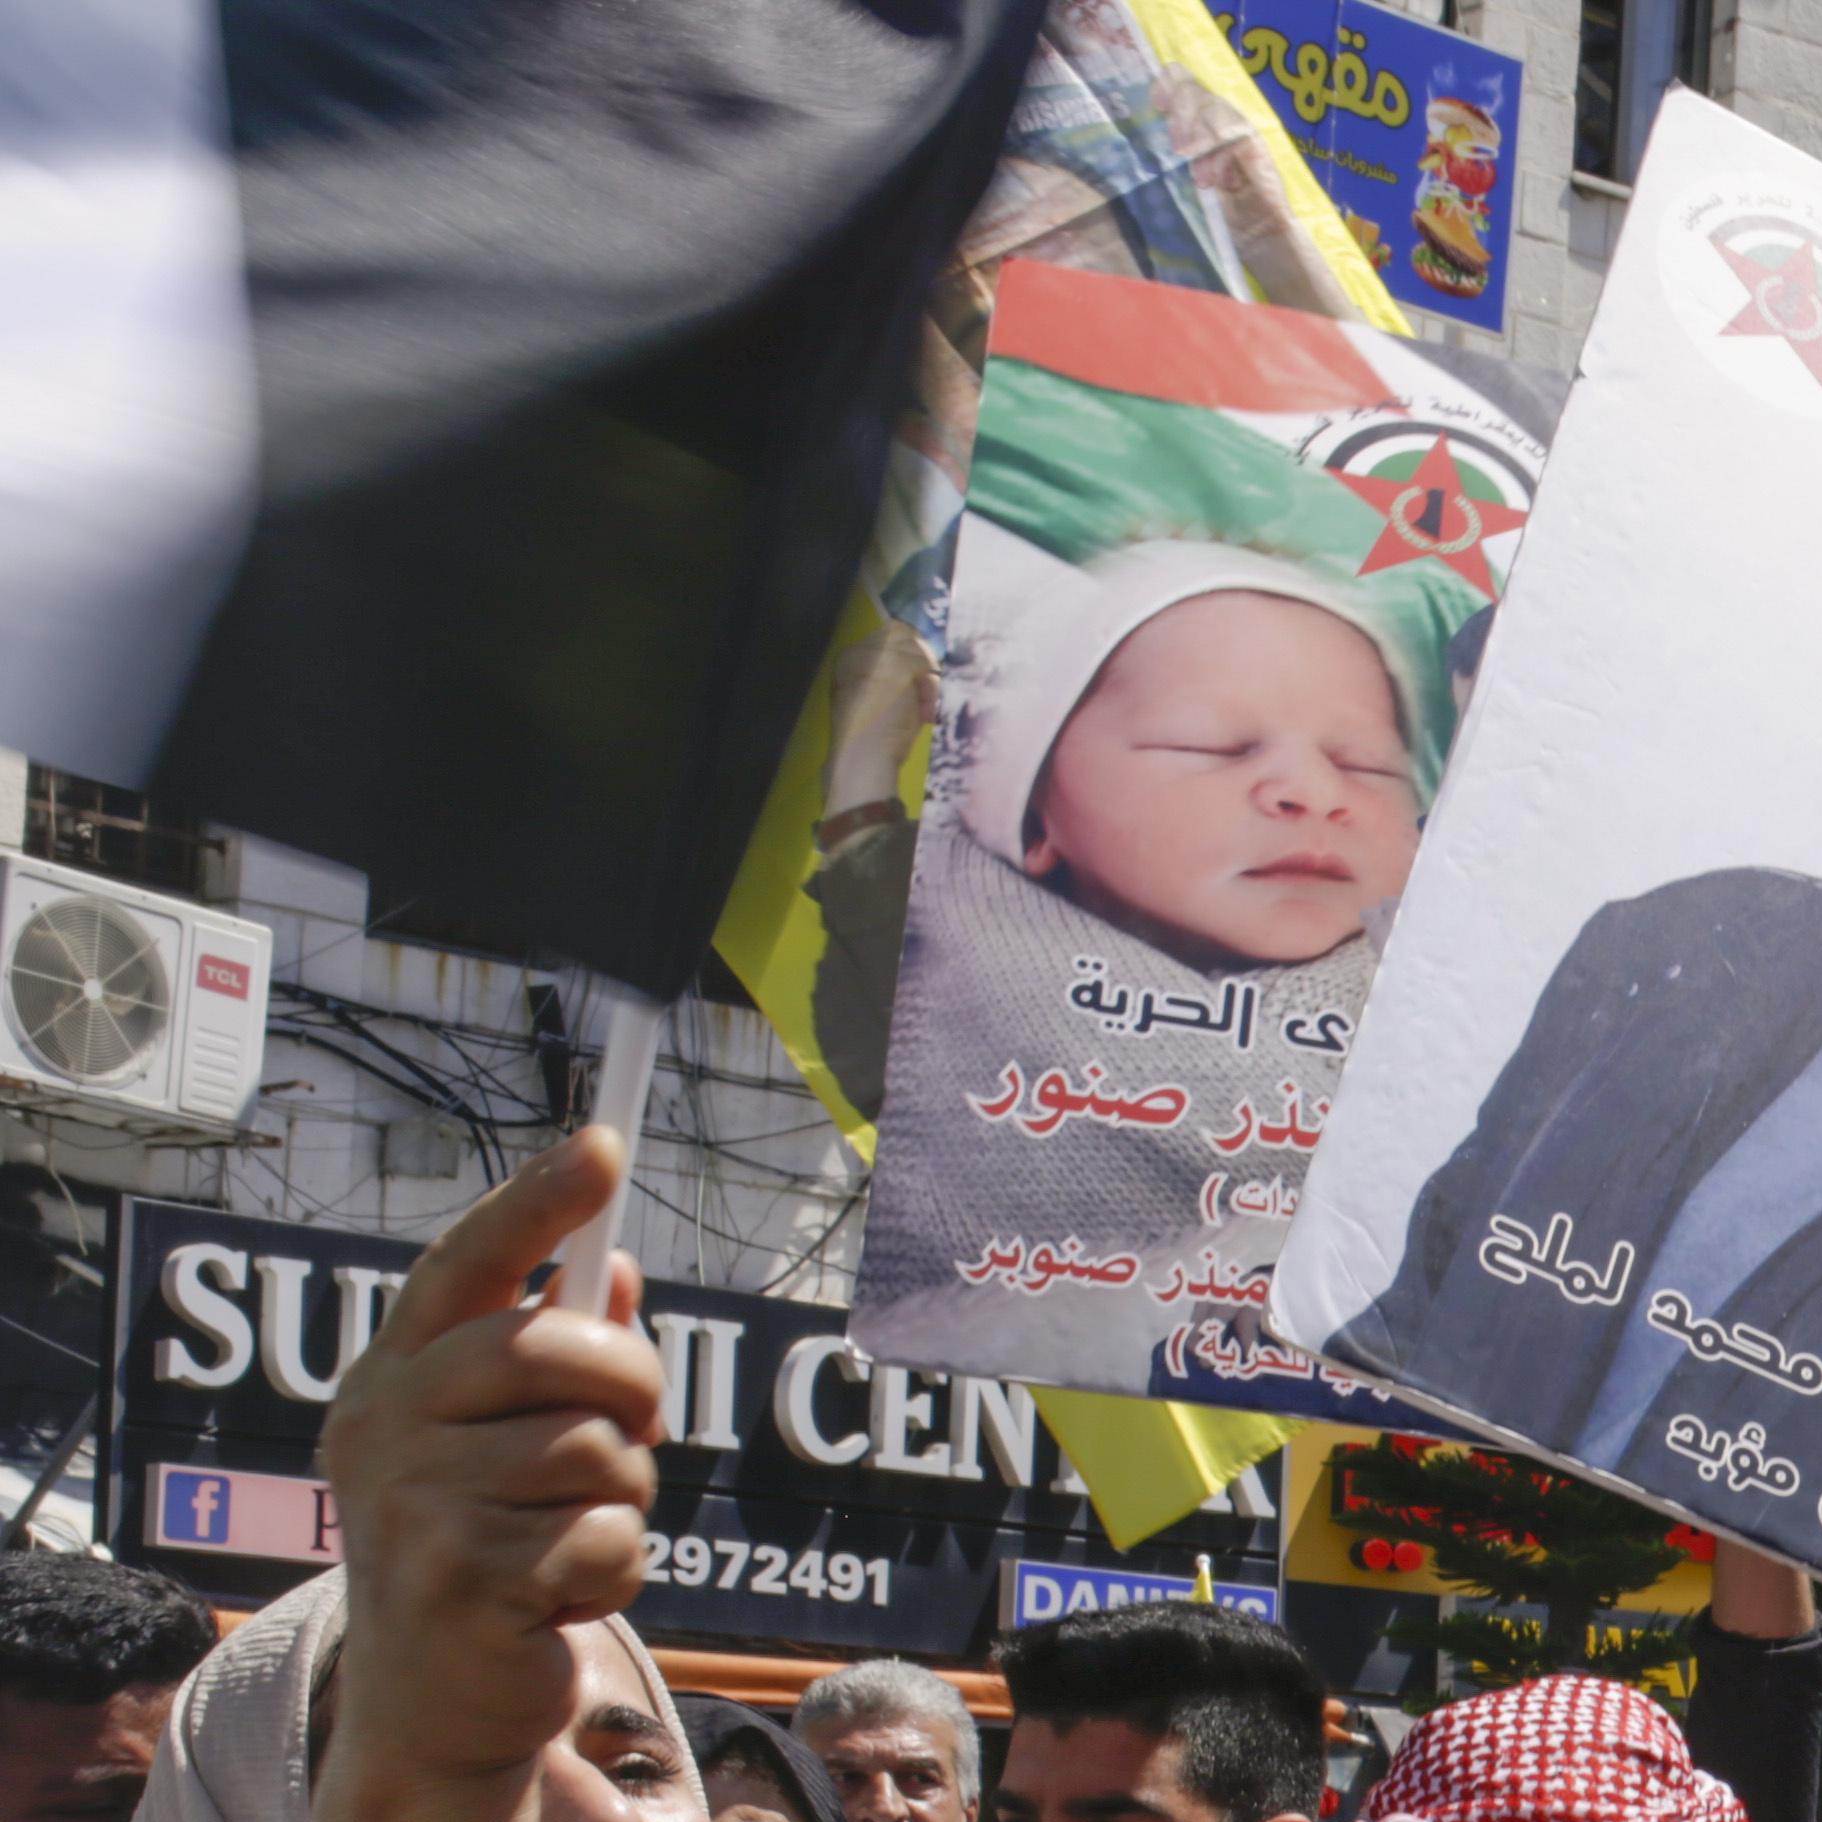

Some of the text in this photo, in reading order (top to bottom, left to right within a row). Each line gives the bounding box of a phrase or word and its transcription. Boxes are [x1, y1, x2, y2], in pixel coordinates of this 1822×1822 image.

[204, 965, 242, 989] TCL
[1068, 954, 1261, 1050] الحرية
[1203, 1076, 1331, 1157] نذر
[954, 1233, 1142, 1297] صنوبر
[1666, 1412, 1800, 1497] مؤبد
